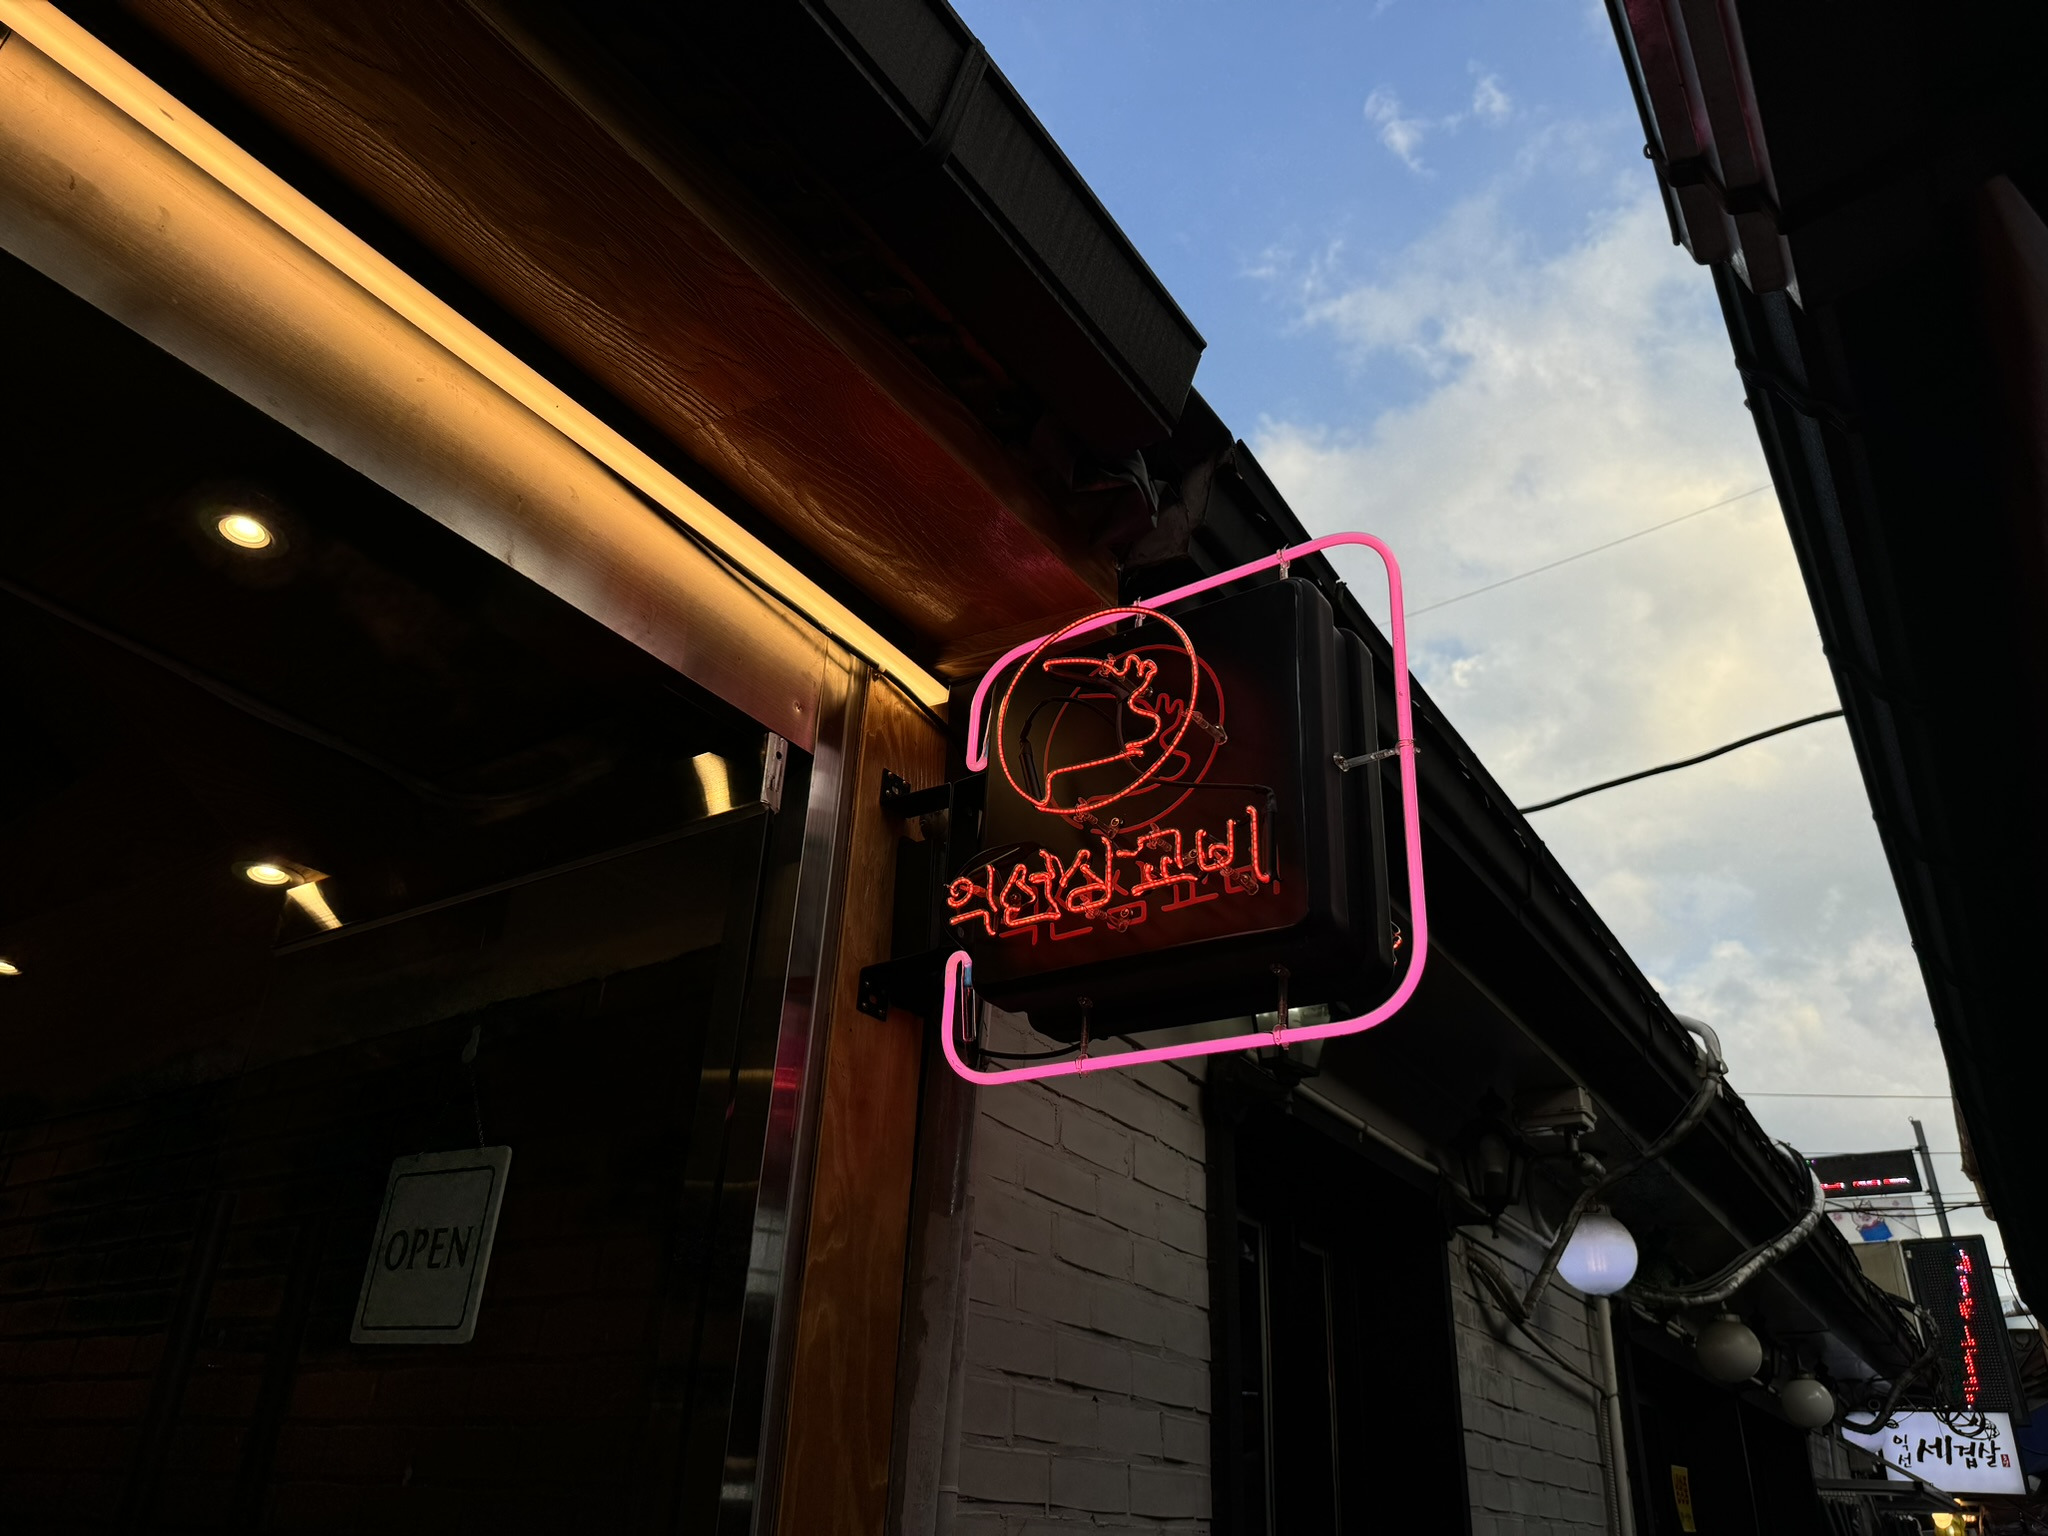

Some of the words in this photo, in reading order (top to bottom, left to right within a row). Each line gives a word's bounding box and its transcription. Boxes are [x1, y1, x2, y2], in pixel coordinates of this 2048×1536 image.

[385, 1225, 474, 1271] OPEN
[1893, 1434, 1912, 1468] 익선
[1917, 1435, 2001, 1469] 세겹살
